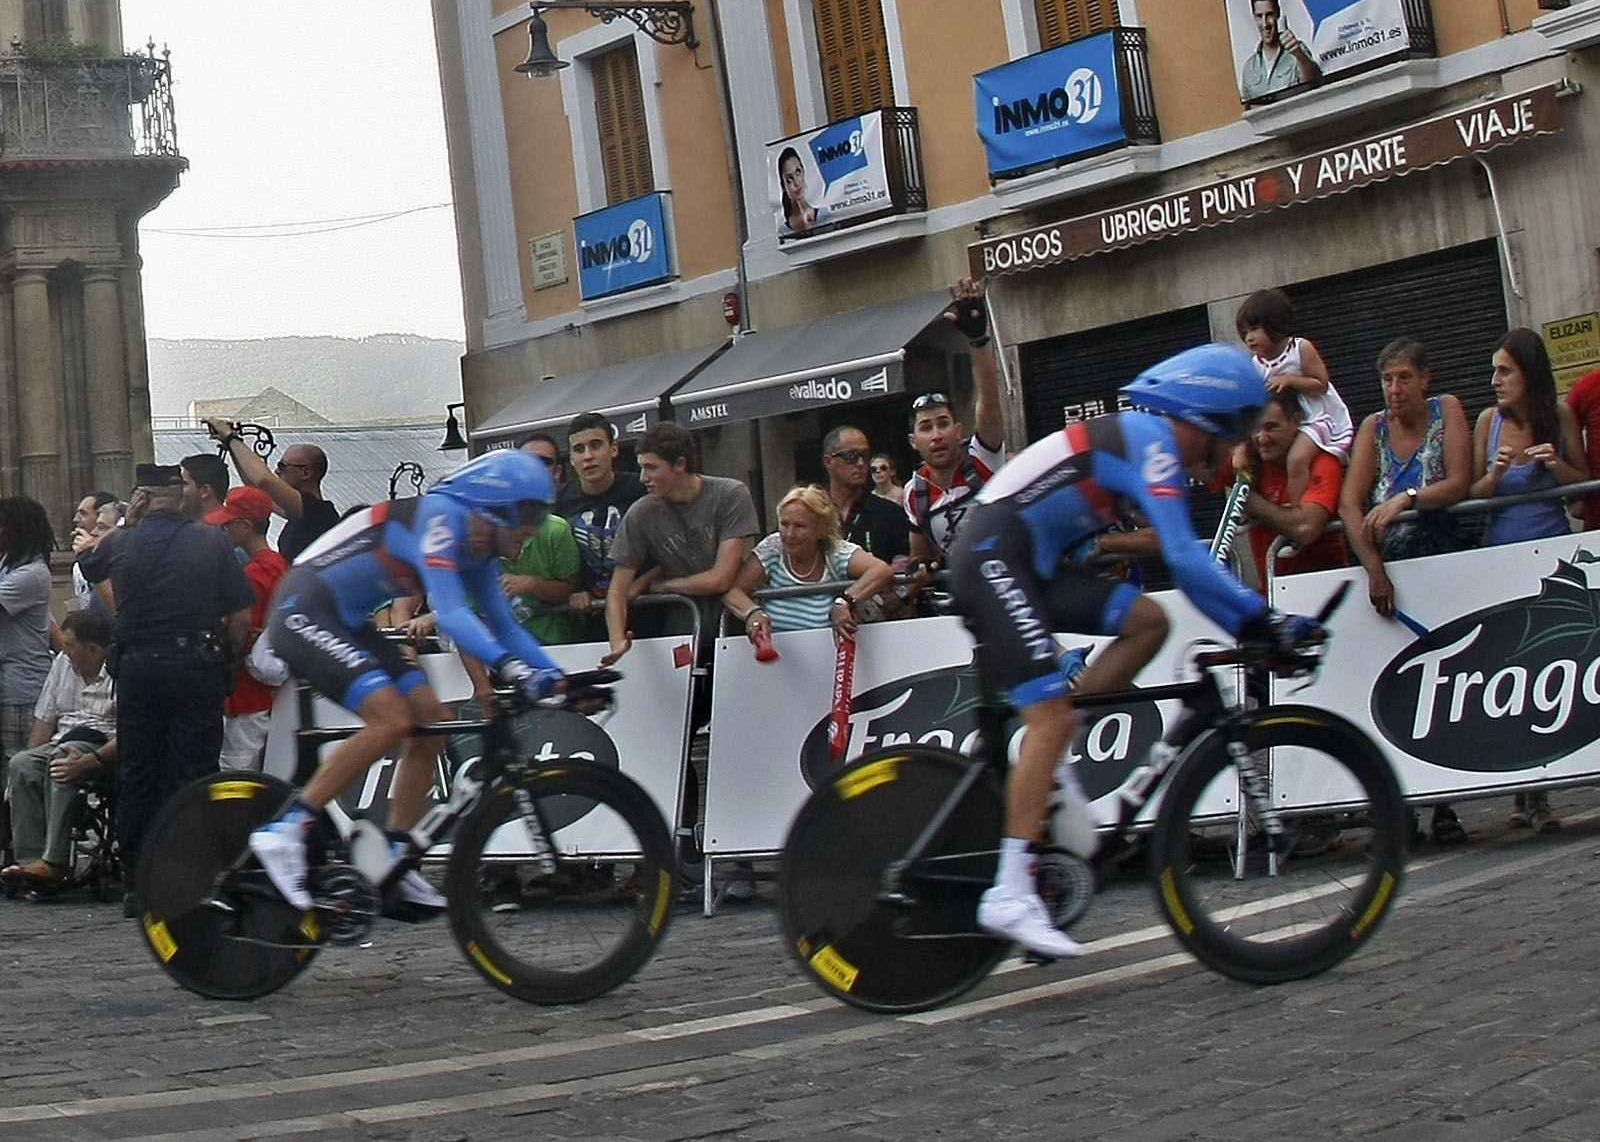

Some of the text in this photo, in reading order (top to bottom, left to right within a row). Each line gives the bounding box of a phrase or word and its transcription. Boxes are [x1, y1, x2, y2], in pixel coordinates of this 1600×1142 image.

[984, 229, 1062, 272] BOLSOS
[1100, 196, 1191, 244] UBRIQUE
[1286, 166, 1303, 194] Y
[1316, 134, 1406, 189] APARTE
[1455, 98, 1535, 148] VIAJE
[1550, 320, 1593, 340] ELIZARI
[689, 403, 729, 422] AMSTEL
[979, 559, 1056, 660] GARMIN
[284, 613, 368, 669] GARMIN
